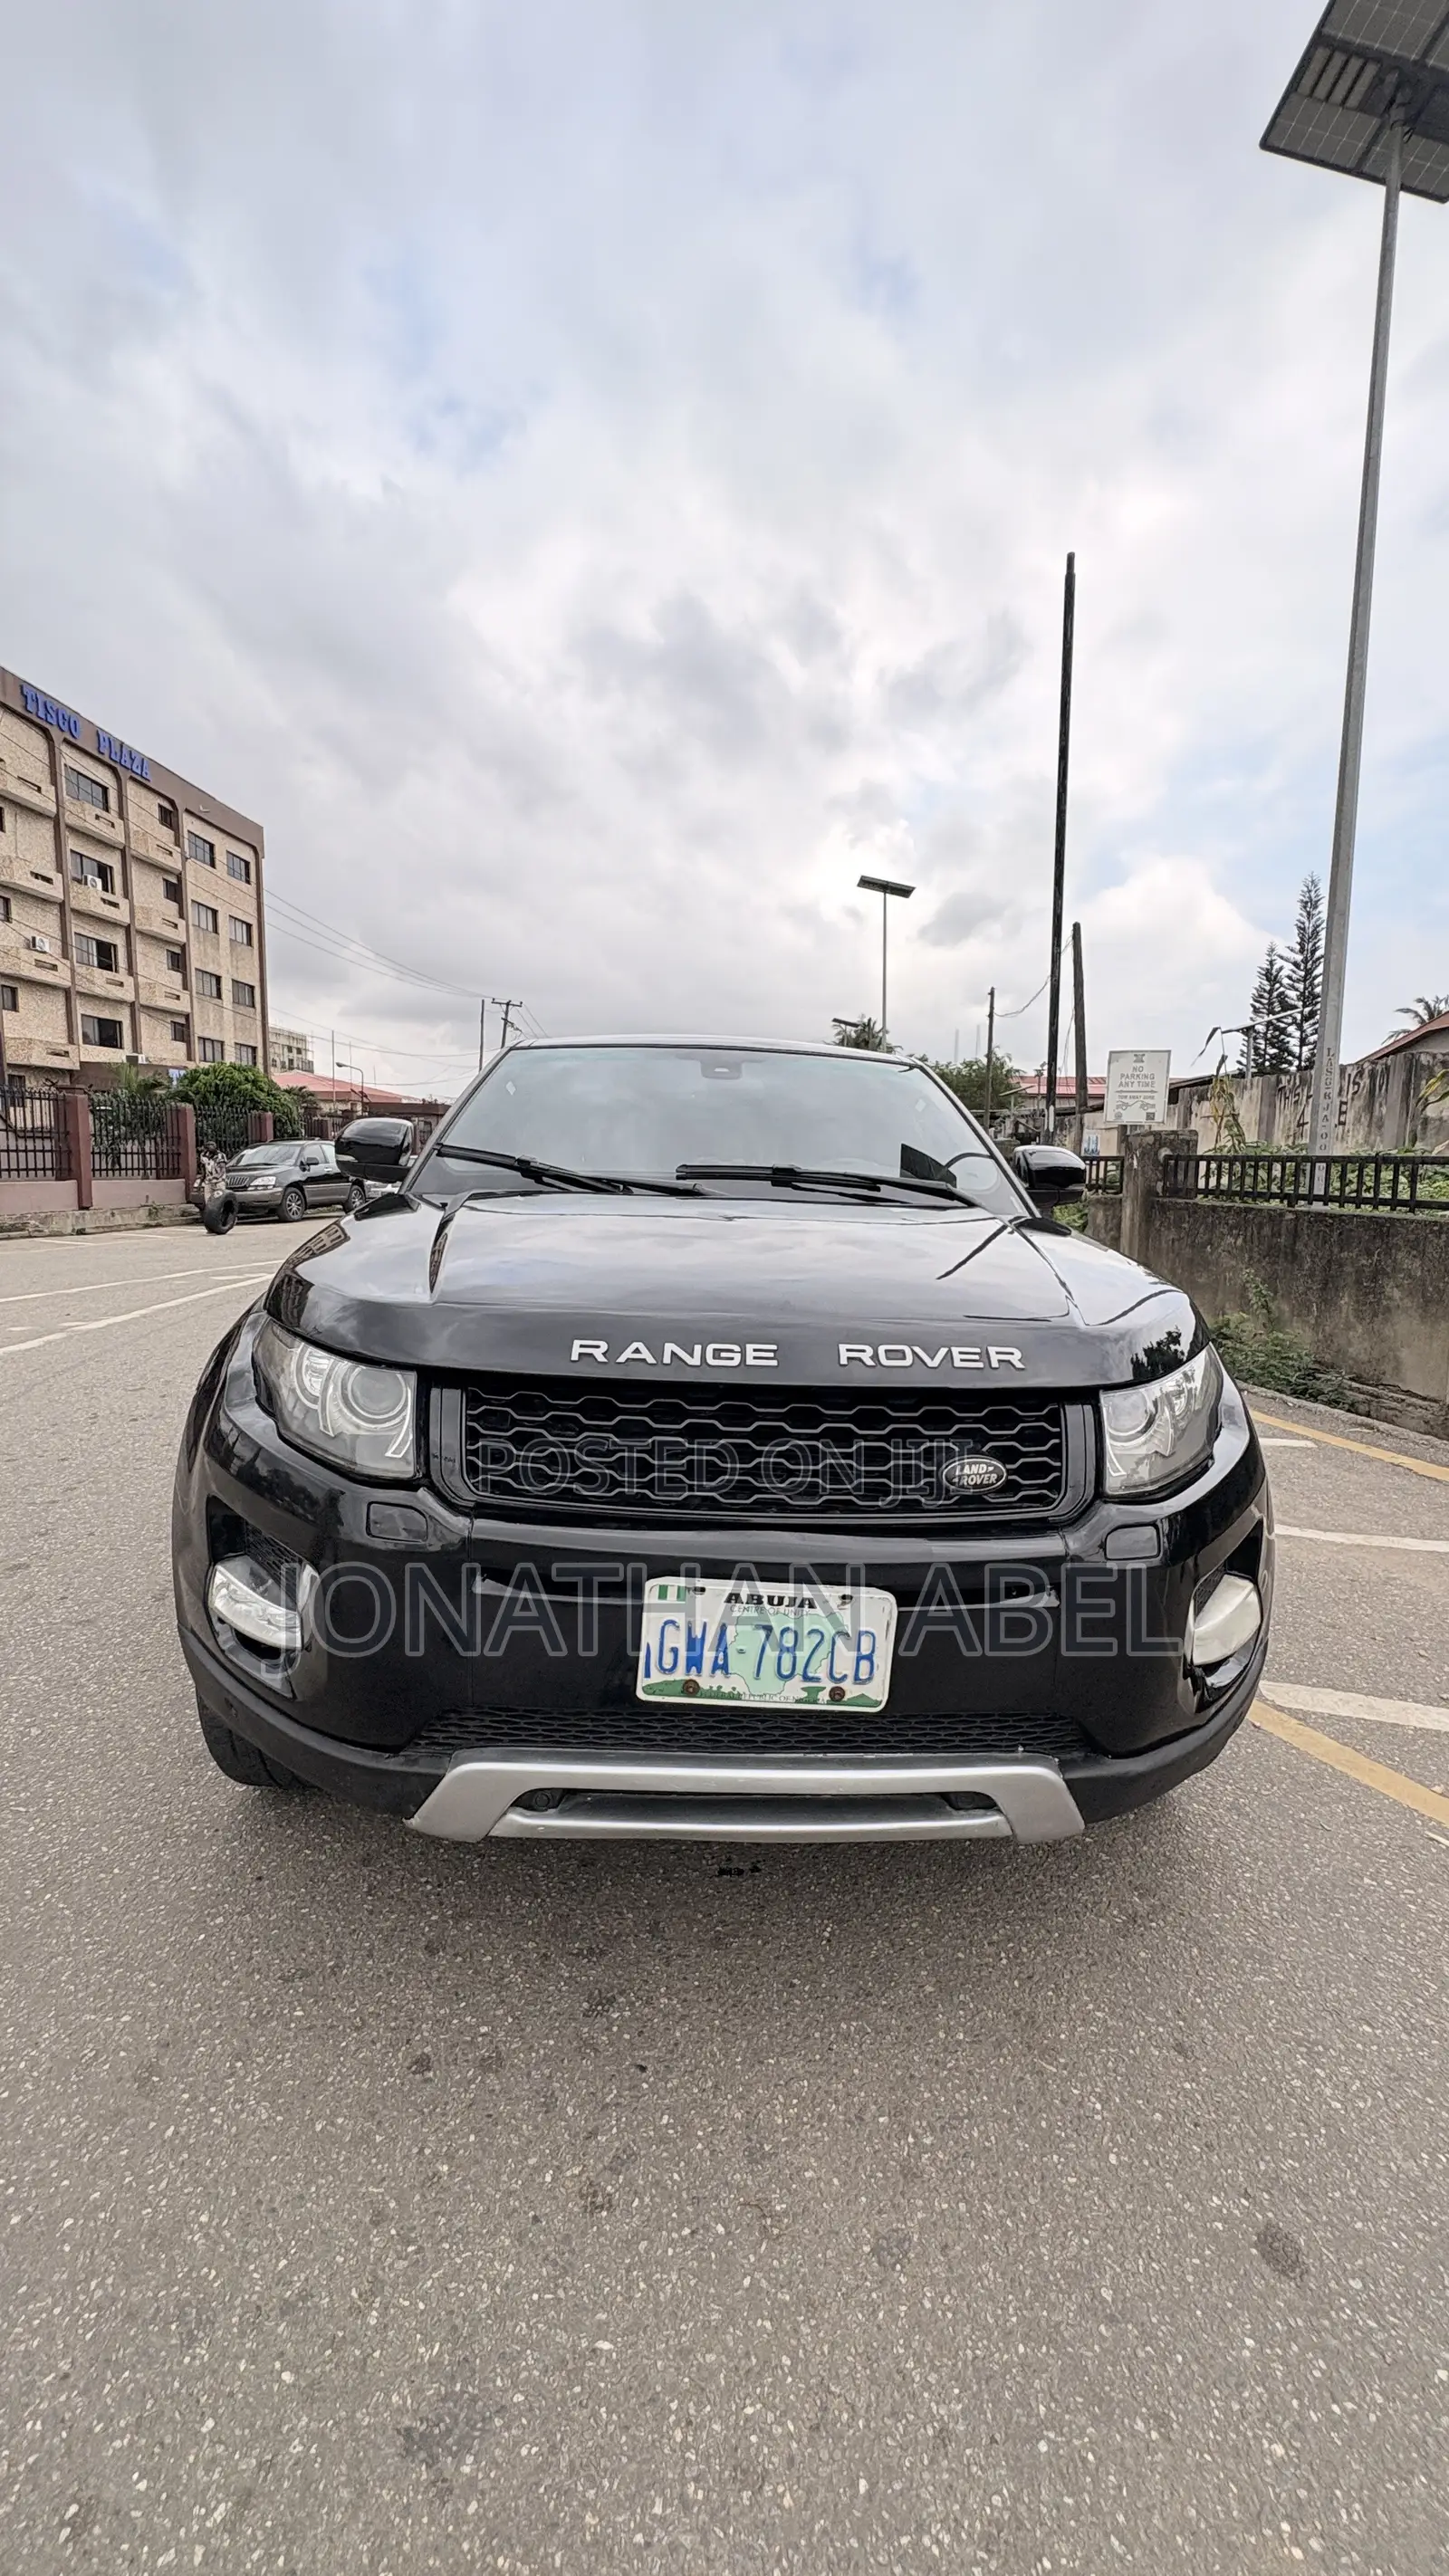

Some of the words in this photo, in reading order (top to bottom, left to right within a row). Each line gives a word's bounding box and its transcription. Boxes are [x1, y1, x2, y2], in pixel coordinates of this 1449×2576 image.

[20, 684, 82, 740] TISCO
[96, 728, 152, 782] PLAZA
[570, 1339, 780, 1367] RANGE
[838, 1343, 1026, 1370] ROVER
[955, 1464, 987, 1476] LAND
[959, 1473, 998, 1486] ROVER
[724, 1593, 817, 1609] ABUJA
[730, 1604, 765, 1615] CENTRE
[767, 1606, 779, 1616] OF
[783, 1608, 811, 1617] UNITY
